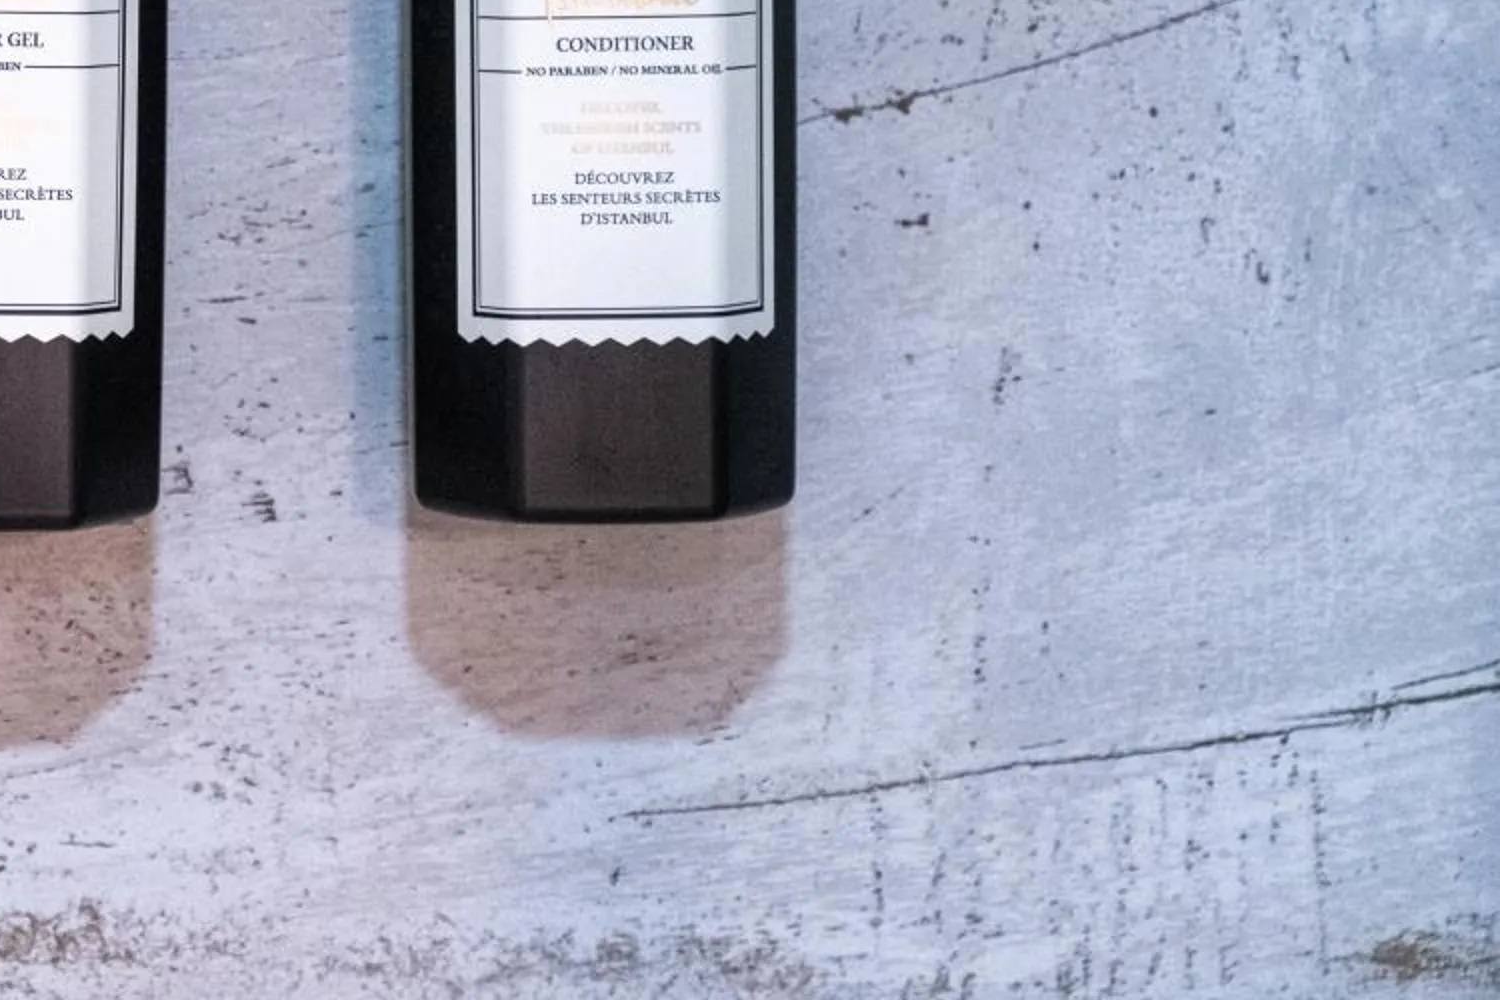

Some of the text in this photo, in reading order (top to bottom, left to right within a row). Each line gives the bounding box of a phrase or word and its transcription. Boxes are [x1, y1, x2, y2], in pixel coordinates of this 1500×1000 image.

[7, 31, 44, 49] GEL
[556, 35, 694, 54] CONDITIONER
[526, 66, 547, 77] NO
[548, 65, 608, 77] PARABEN
[619, 65, 639, 76] NO
[641, 64, 699, 76] MINERAL
[575, 169, 674, 186] DÉCOUVREZ
[532, 188, 720, 206] LES SENTEURS SECRÈTES
